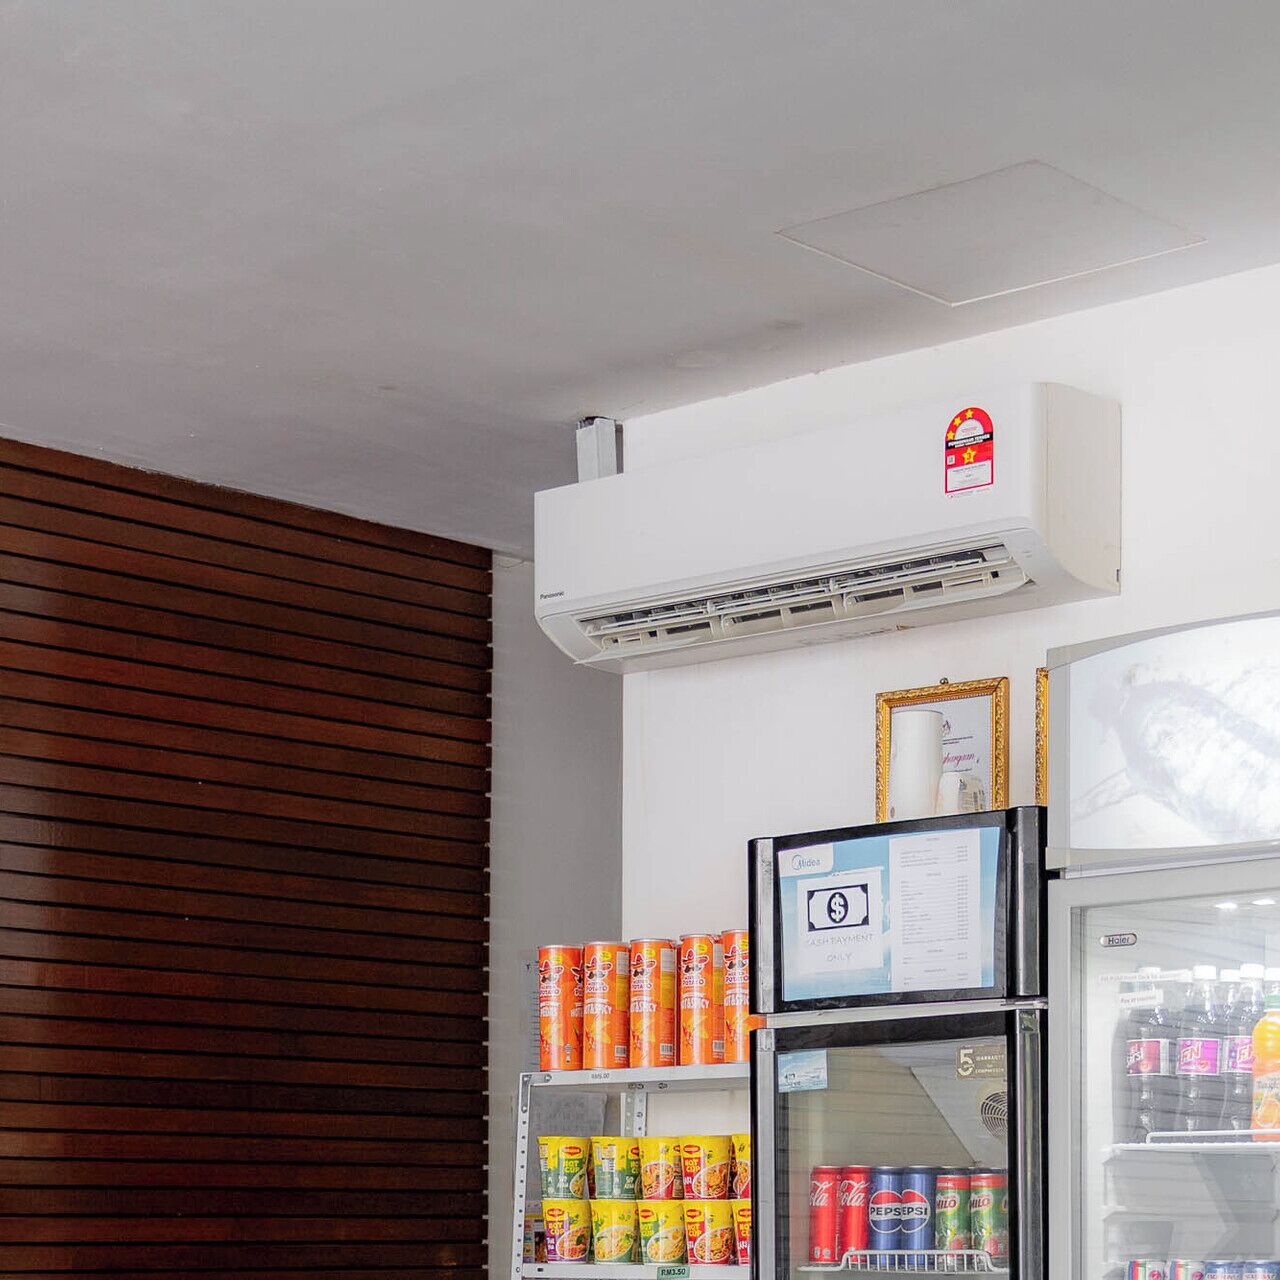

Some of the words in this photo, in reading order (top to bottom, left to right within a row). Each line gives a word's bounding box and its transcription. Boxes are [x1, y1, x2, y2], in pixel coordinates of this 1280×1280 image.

[540, 591, 564, 599] Panasonic
[794, 857, 820, 869] Midea
[661, 1267, 686, 1276] RM3.50
